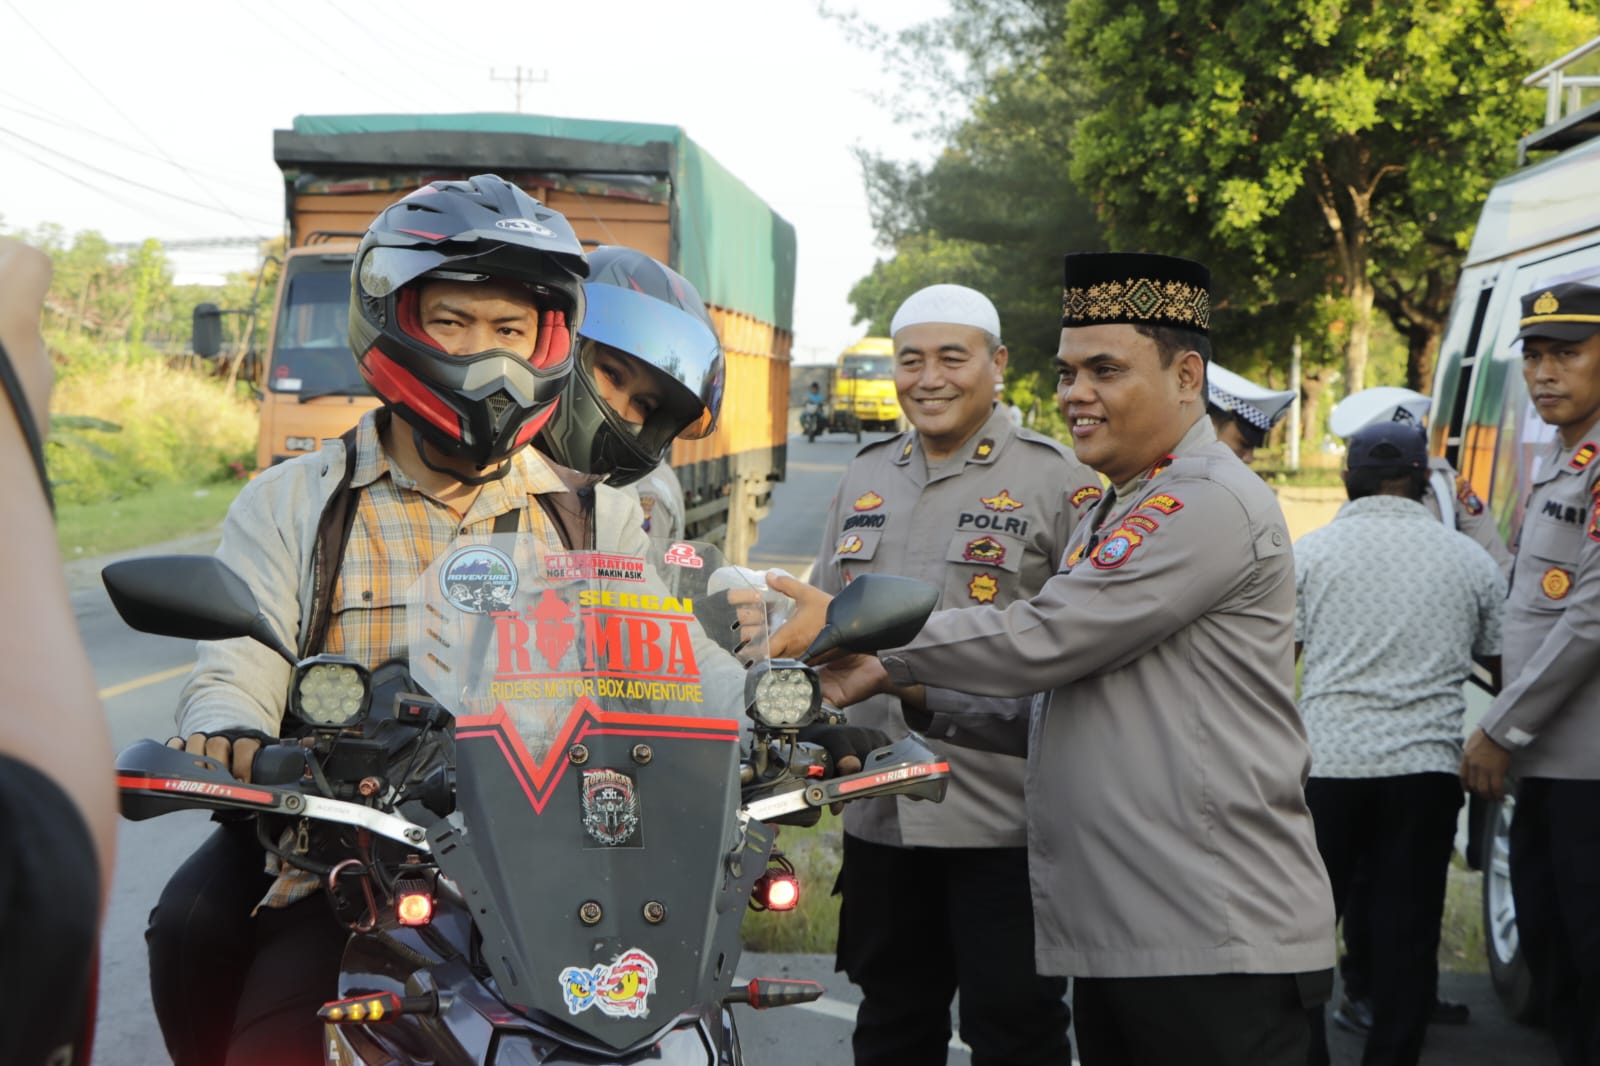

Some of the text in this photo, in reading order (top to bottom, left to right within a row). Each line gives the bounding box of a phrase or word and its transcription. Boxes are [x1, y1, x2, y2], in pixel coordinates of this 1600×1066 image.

[958, 512, 1028, 536] POLRI
[598, 568, 623, 578] MAKIN
[624, 570, 642, 579] ASIK
[579, 590, 693, 614] SERGAI
[494, 612, 701, 676] RMBA
[490, 678, 704, 703] RIDERS MOTOR BOX ADVENTURE
[887, 767, 909, 782] RIDE
[176, 780, 220, 794] RIDE IT
